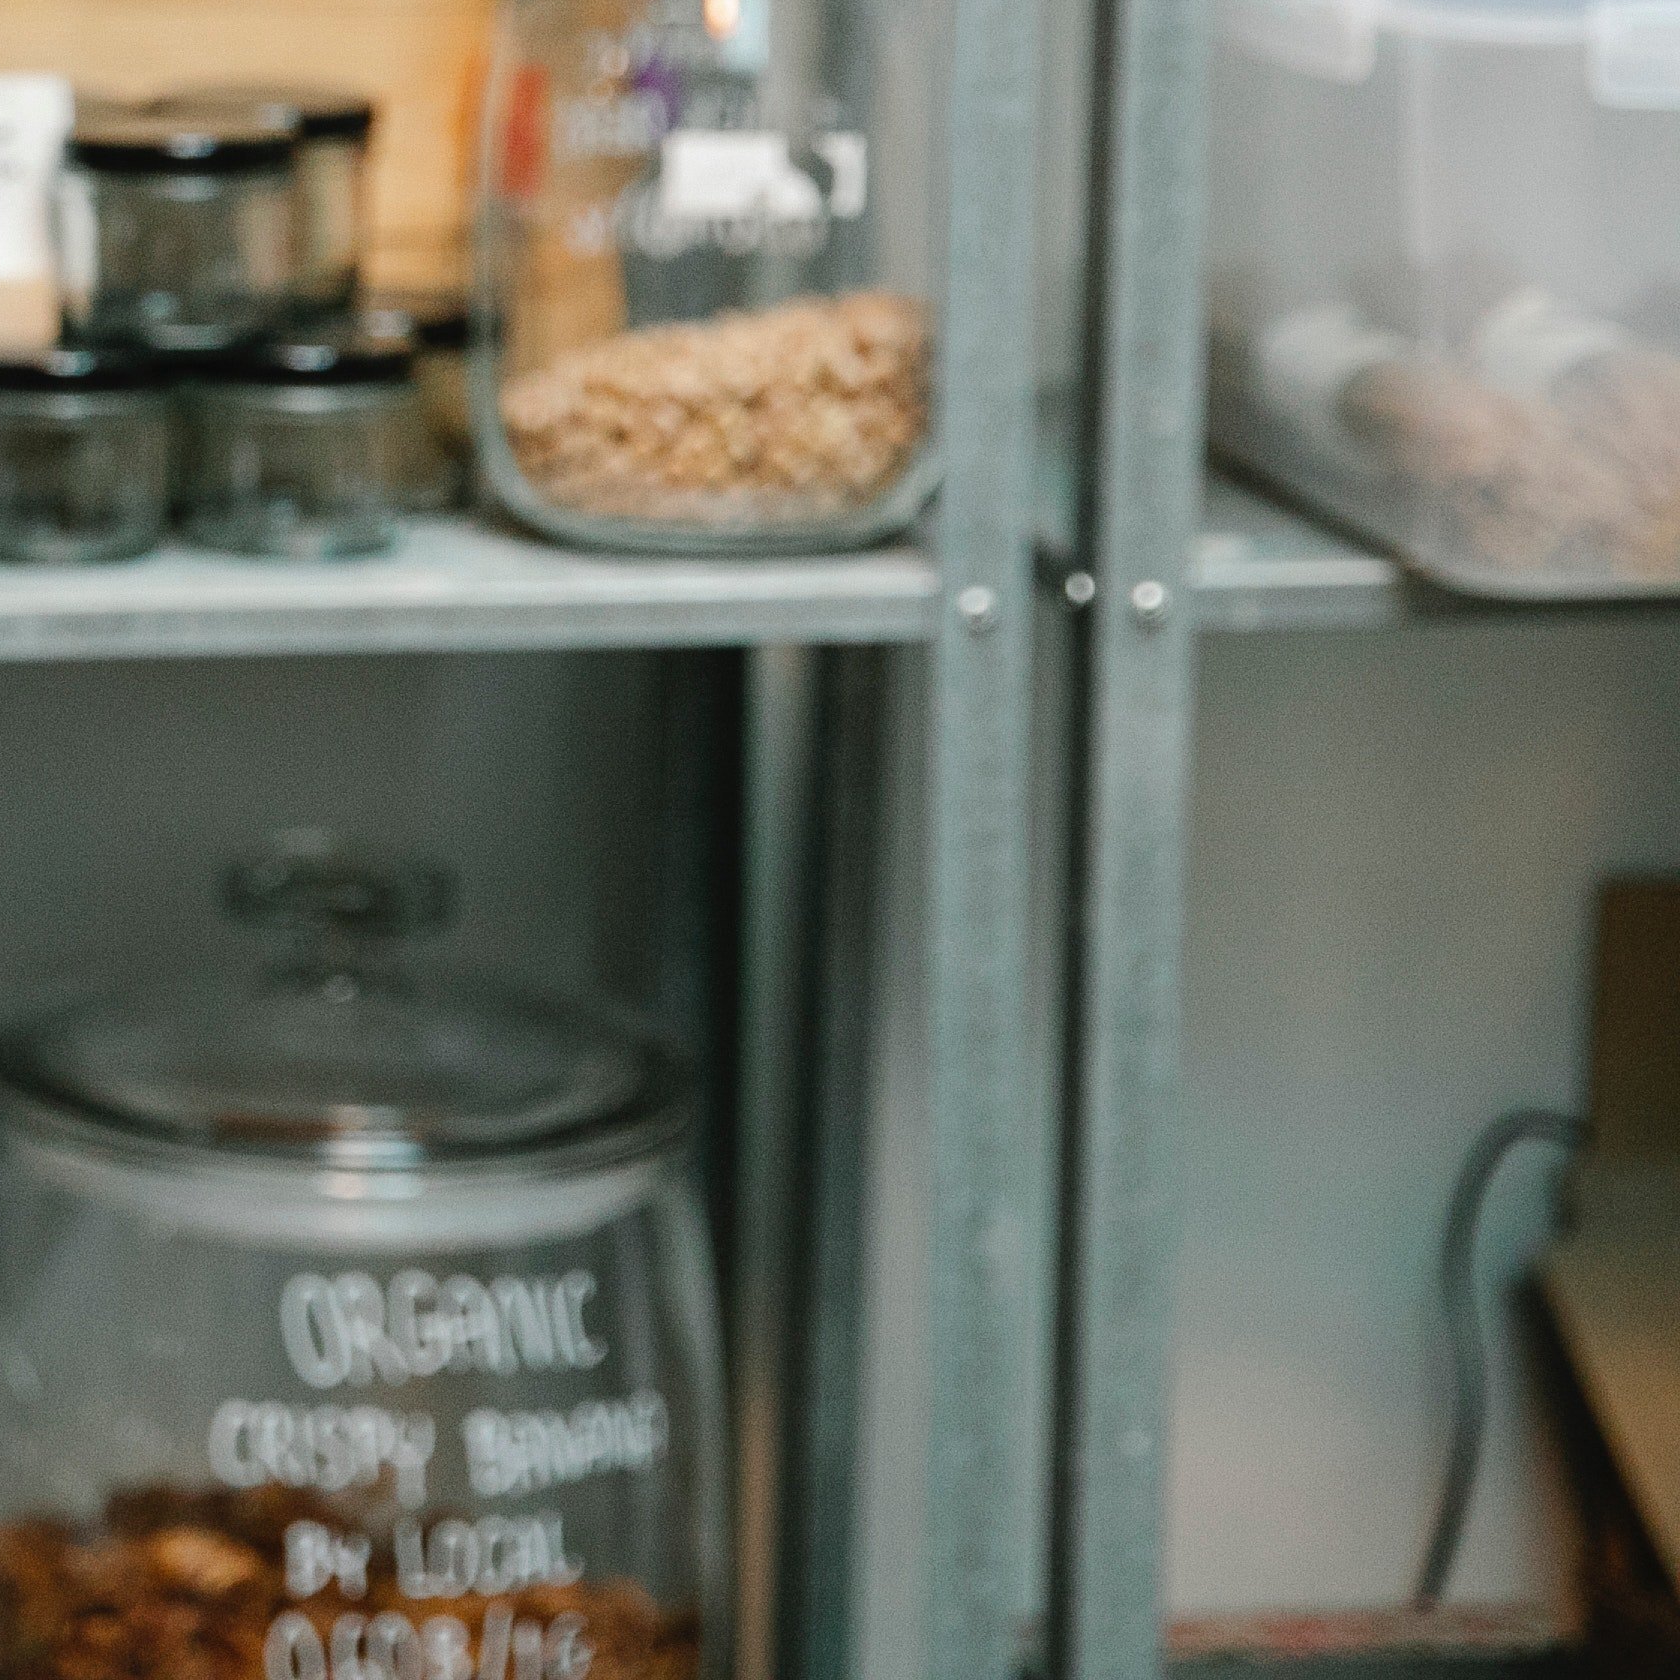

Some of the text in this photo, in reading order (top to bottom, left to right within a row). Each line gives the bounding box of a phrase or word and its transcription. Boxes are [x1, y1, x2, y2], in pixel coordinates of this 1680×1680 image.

[278, 1269, 608, 1388] ORGANIC
[208, 1397, 436, 1509] CRISPY
[285, 1511, 584, 1598] BY LOCAL
